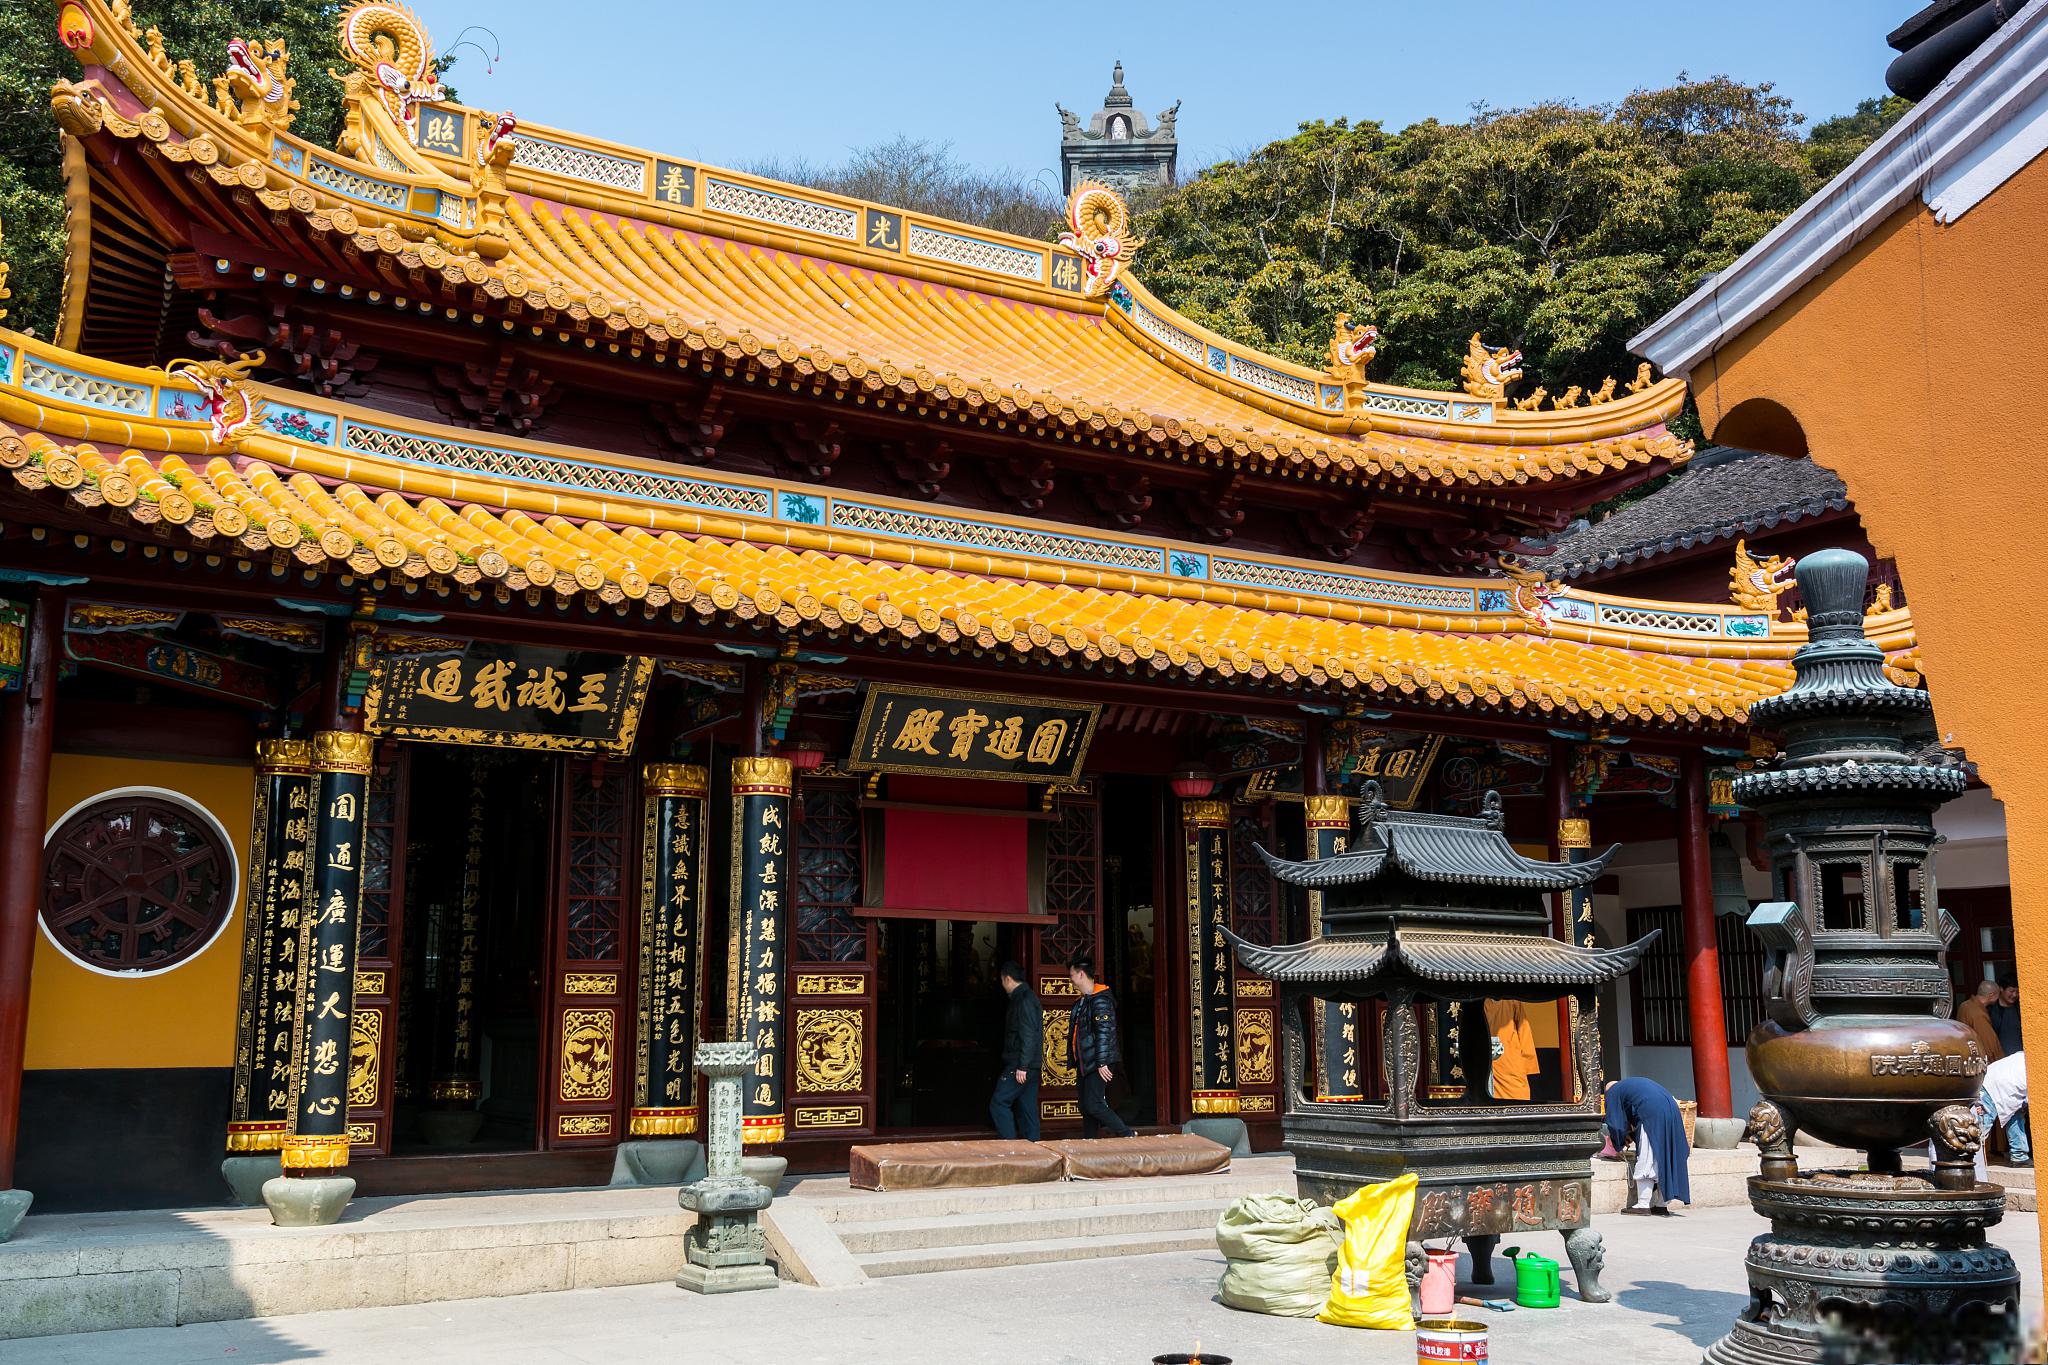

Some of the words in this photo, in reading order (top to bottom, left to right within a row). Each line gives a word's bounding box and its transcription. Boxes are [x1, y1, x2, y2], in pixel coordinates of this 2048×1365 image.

[423, 115, 460, 155] 照
[658, 165, 690, 204] 普
[869, 217, 899, 250] 光
